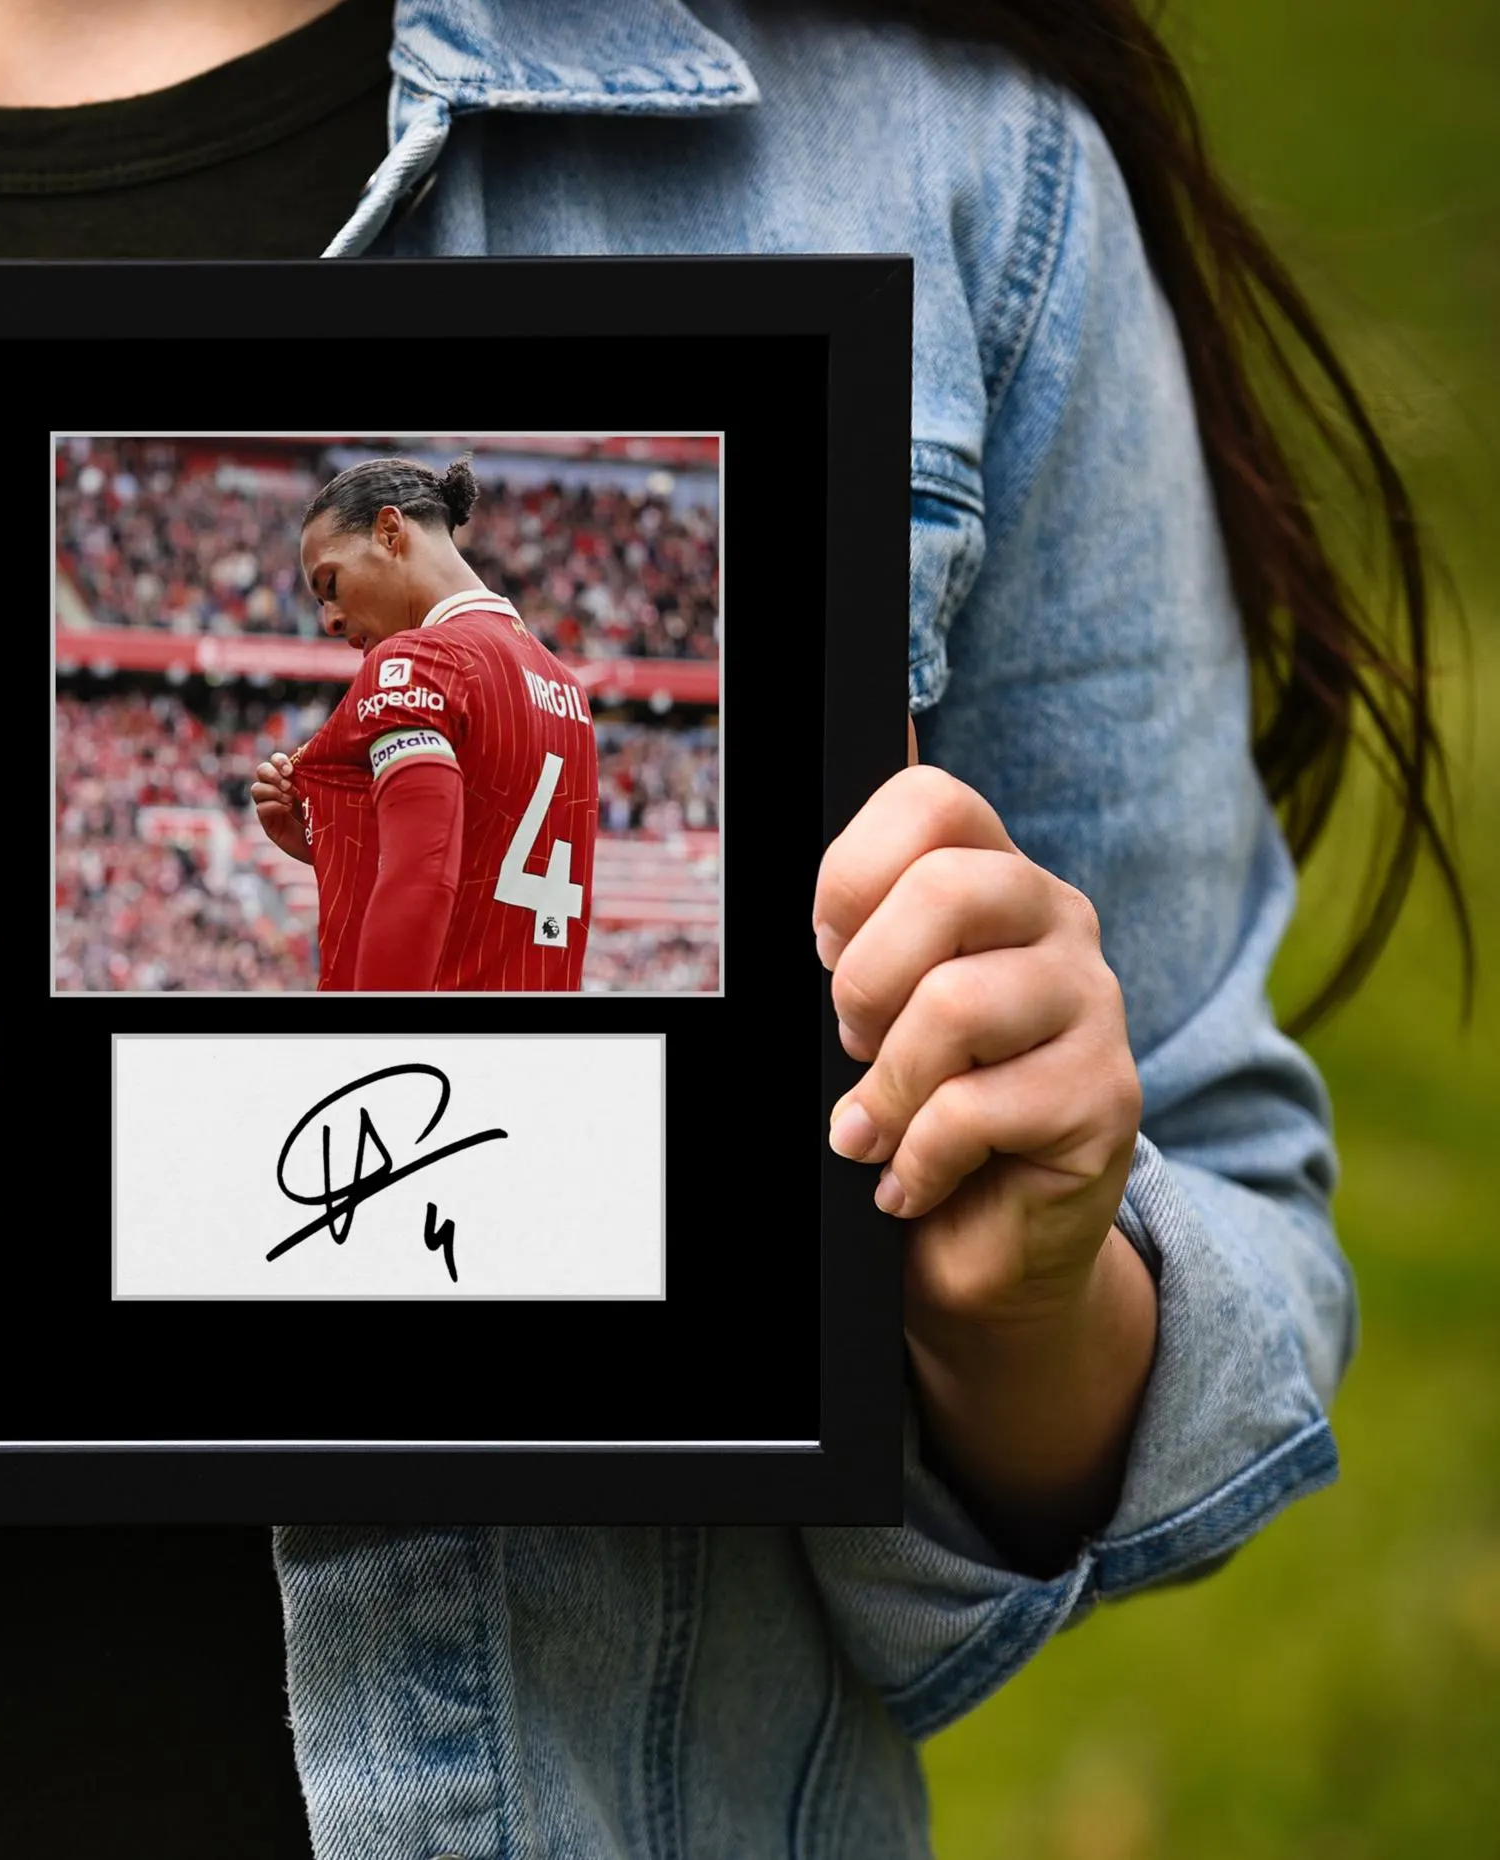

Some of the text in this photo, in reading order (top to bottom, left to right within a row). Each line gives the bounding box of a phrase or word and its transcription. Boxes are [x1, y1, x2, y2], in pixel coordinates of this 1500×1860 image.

[357, 687, 445, 723] Expedia
[522, 665, 589, 725] VIRGIL
[493, 752, 584, 948] 4
